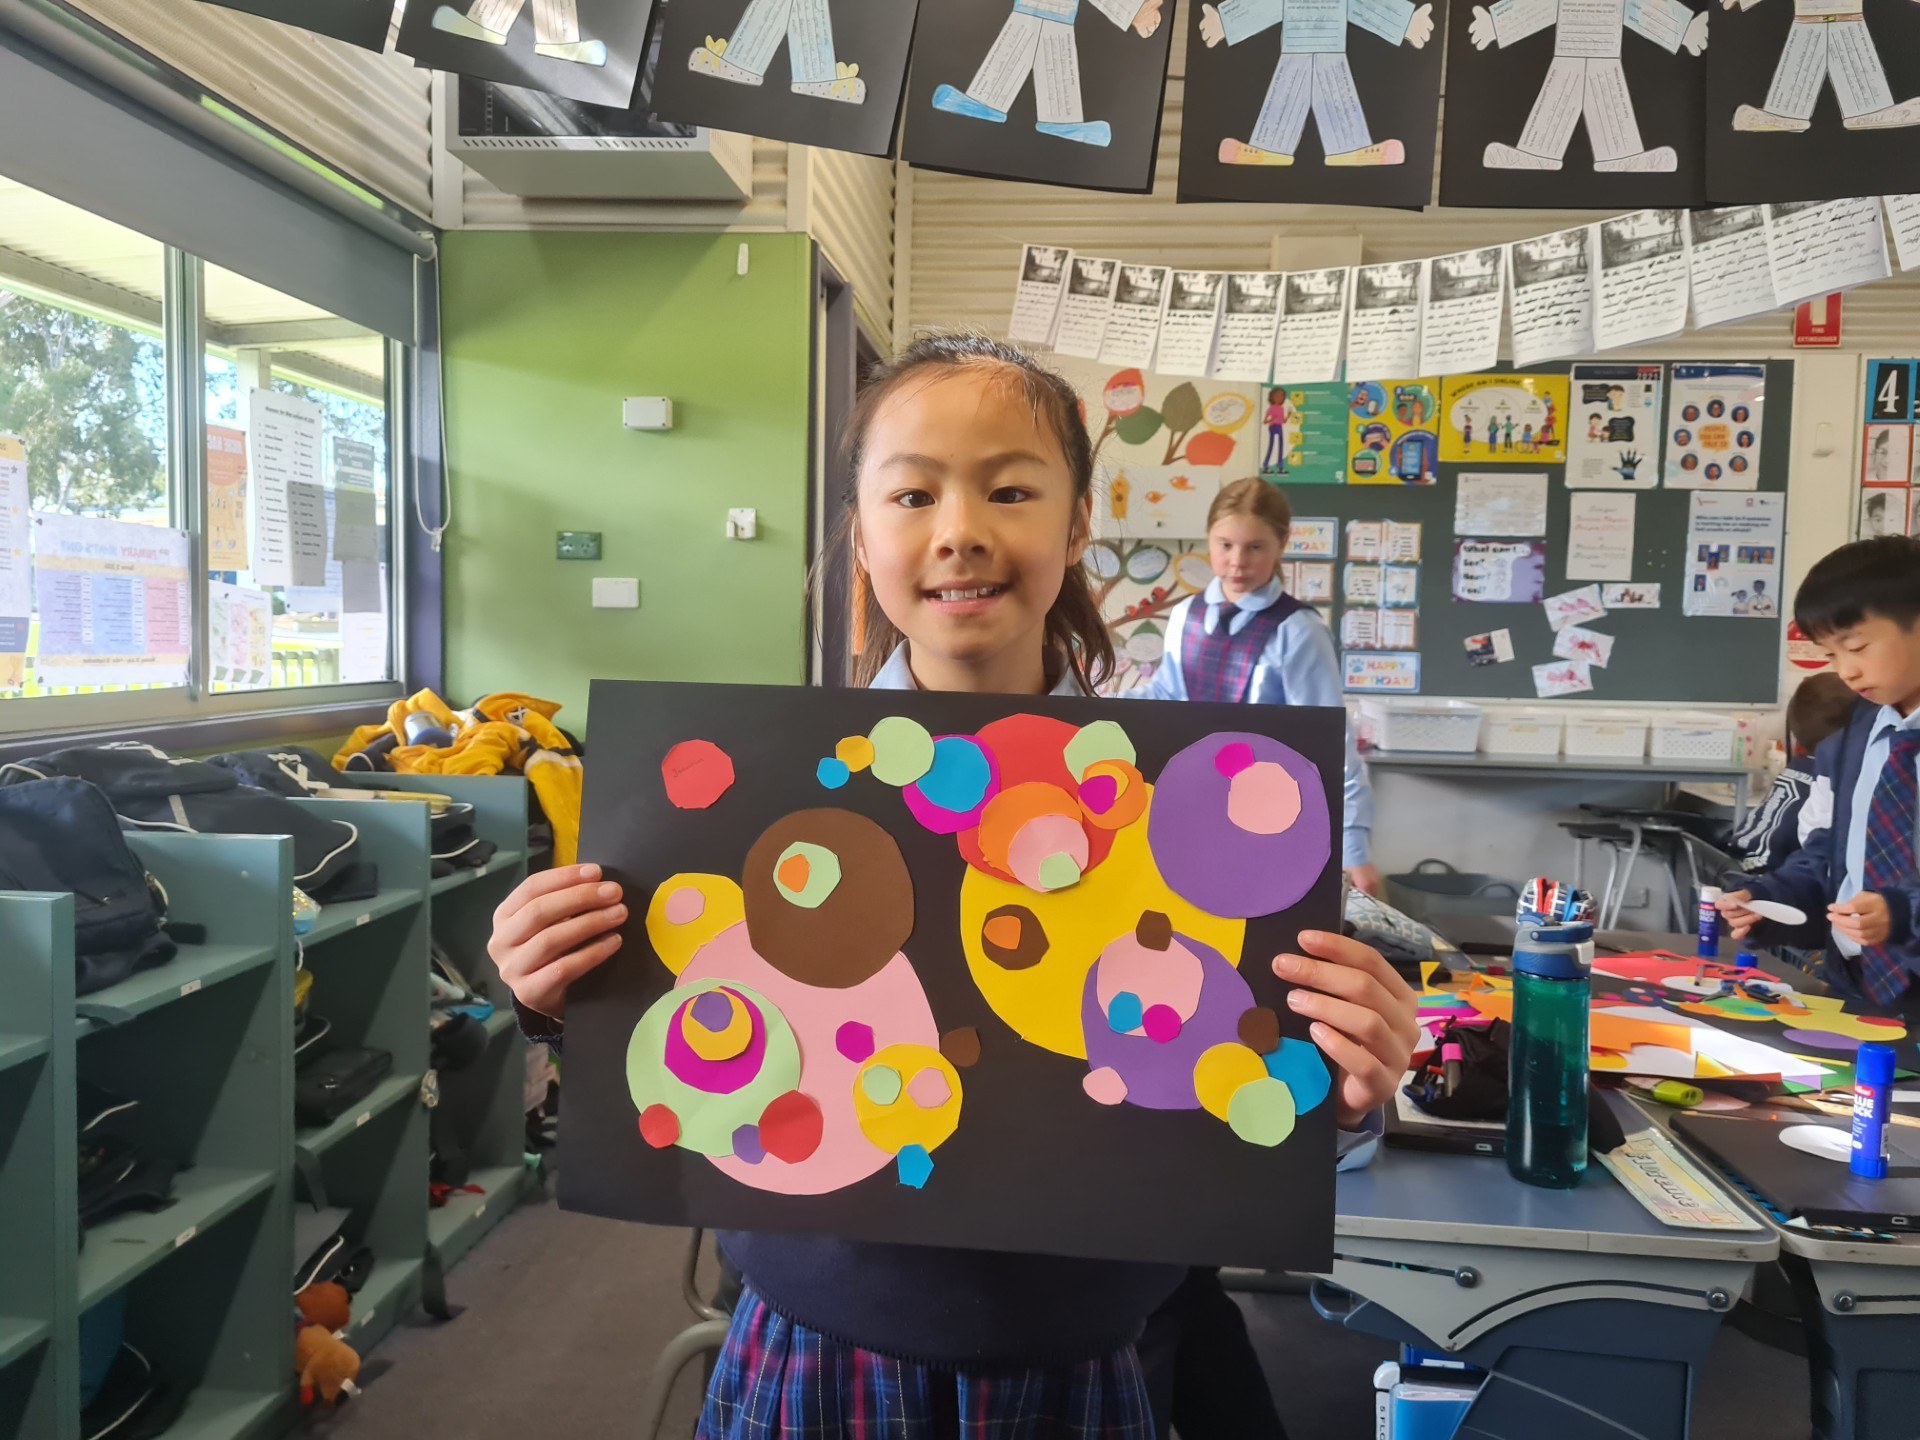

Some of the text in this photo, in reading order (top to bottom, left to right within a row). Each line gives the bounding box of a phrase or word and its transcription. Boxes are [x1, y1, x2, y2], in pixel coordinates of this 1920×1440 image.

[1878, 369, 1900, 413] 4
[1367, 661, 1407, 671] HAPPY
[1348, 675, 1411, 685] BIRTHDAY
[1854, 1094, 1874, 1109] LUE
[1625, 1152, 1700, 1208] Florence
